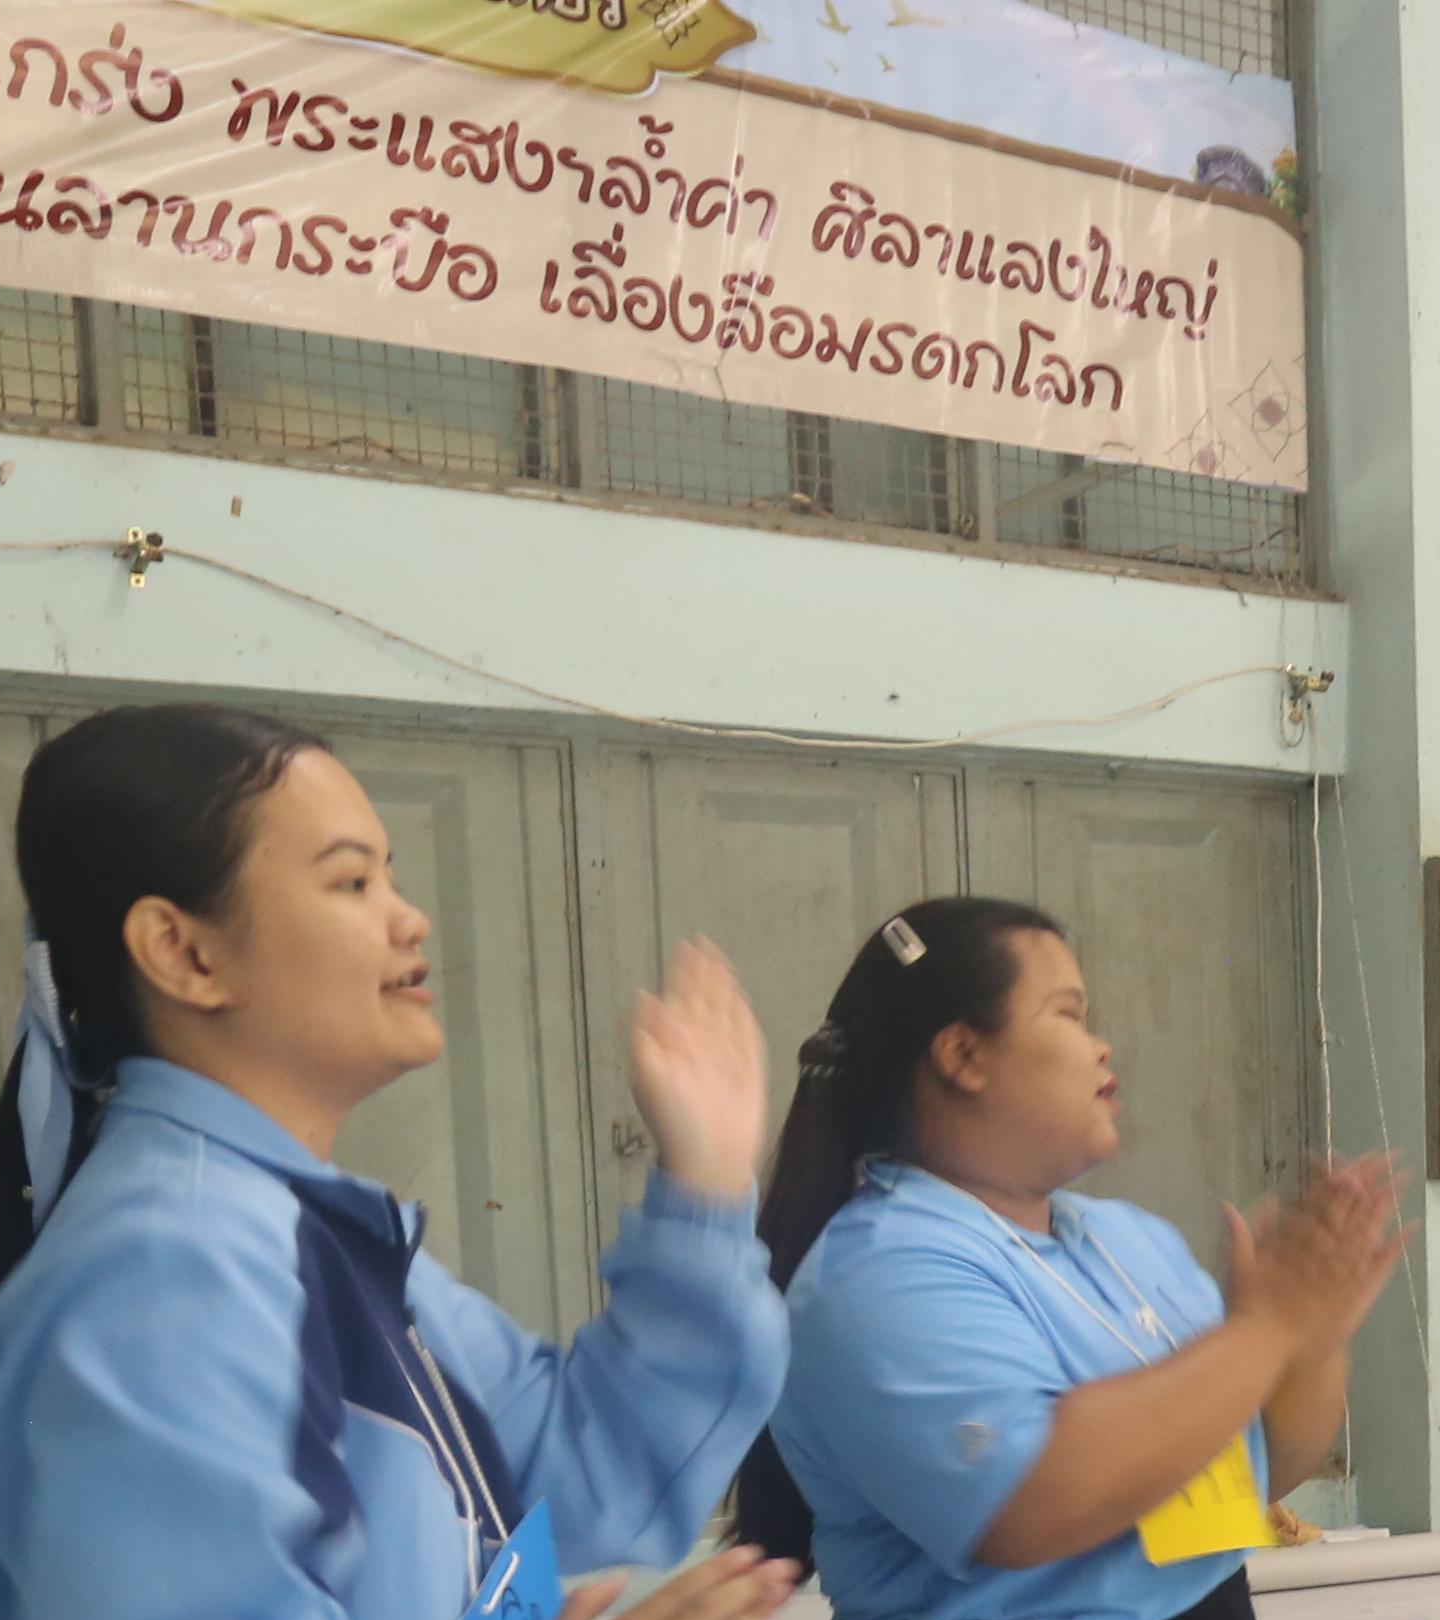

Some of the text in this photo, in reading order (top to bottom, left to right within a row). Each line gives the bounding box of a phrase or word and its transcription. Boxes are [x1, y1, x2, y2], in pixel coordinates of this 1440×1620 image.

[540, 222, 1124, 412] เลื่องลือมรดกโลก
[811, 181, 1218, 341] ศิลาแลงใหญ่
